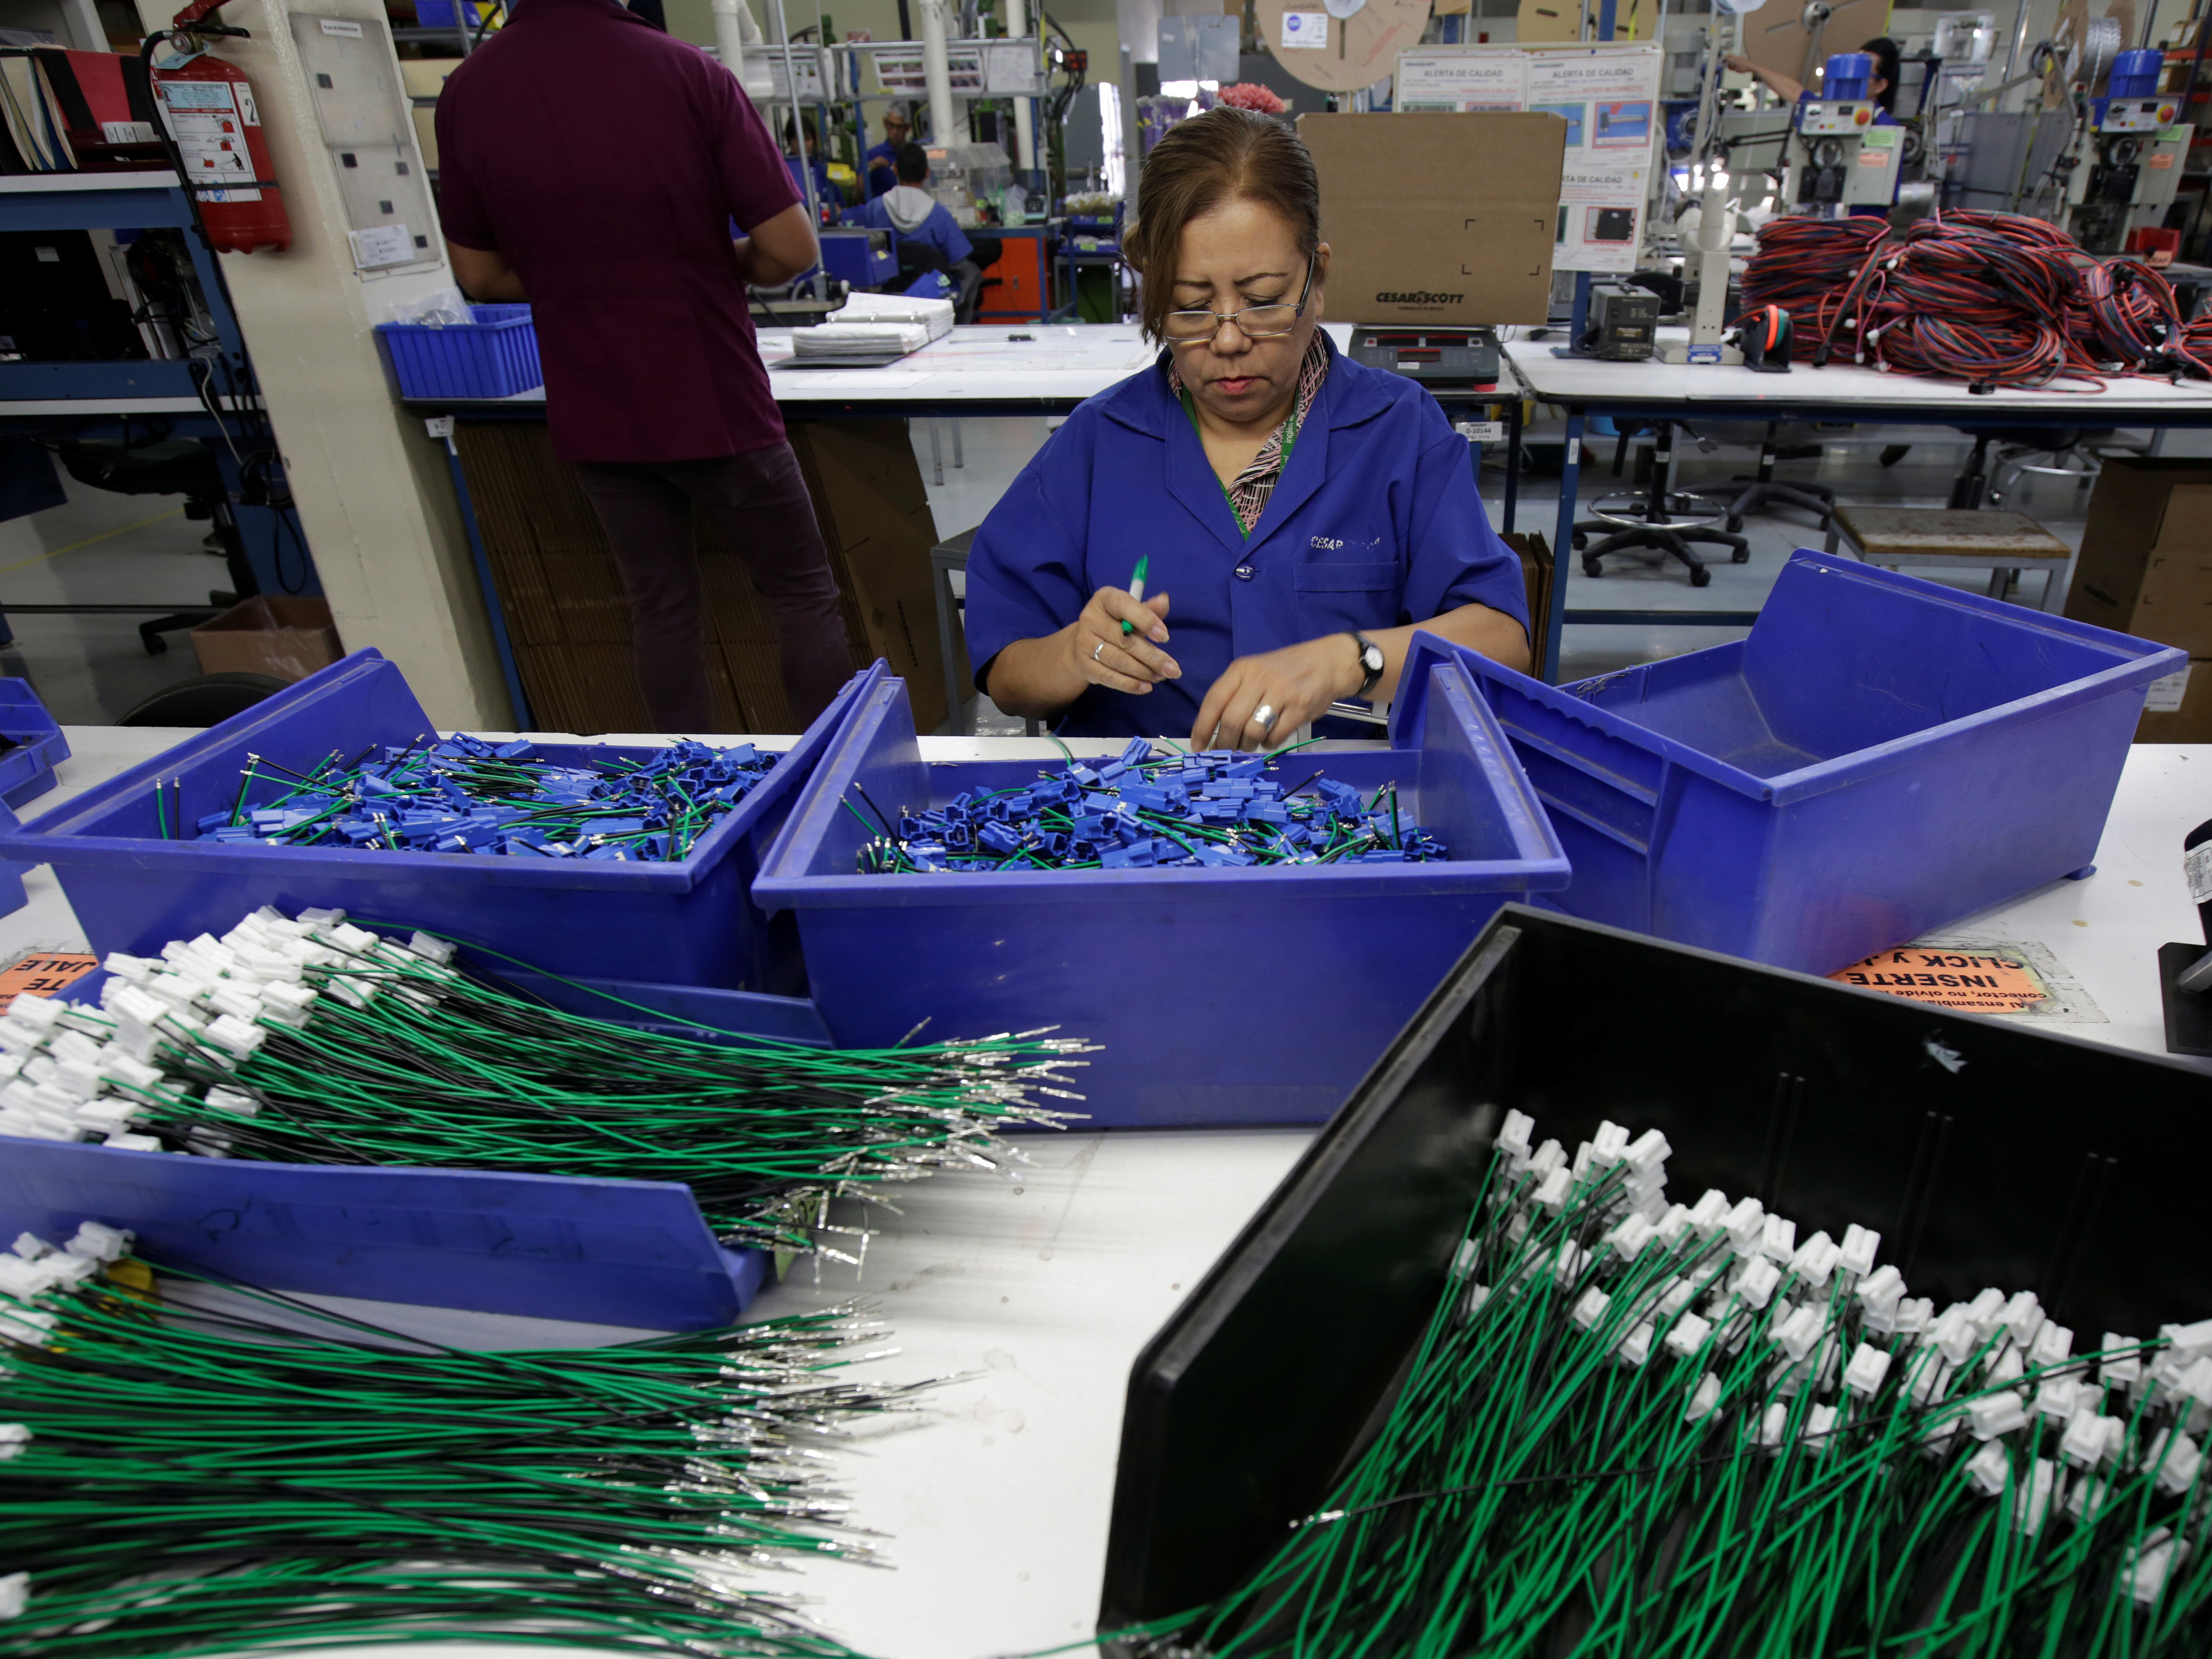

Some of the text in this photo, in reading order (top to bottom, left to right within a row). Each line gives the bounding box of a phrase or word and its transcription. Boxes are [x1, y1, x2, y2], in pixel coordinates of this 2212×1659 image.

[1599, 68, 1634, 76] CALIDAD
[1376, 292, 1465, 303] CESAR SCOTT
[1893, 952, 1911, 963] y
[1918, 955, 2024, 970] CLICK
[14, 960, 97, 972] JALE
[1846, 973, 1999, 988] INSERTE
